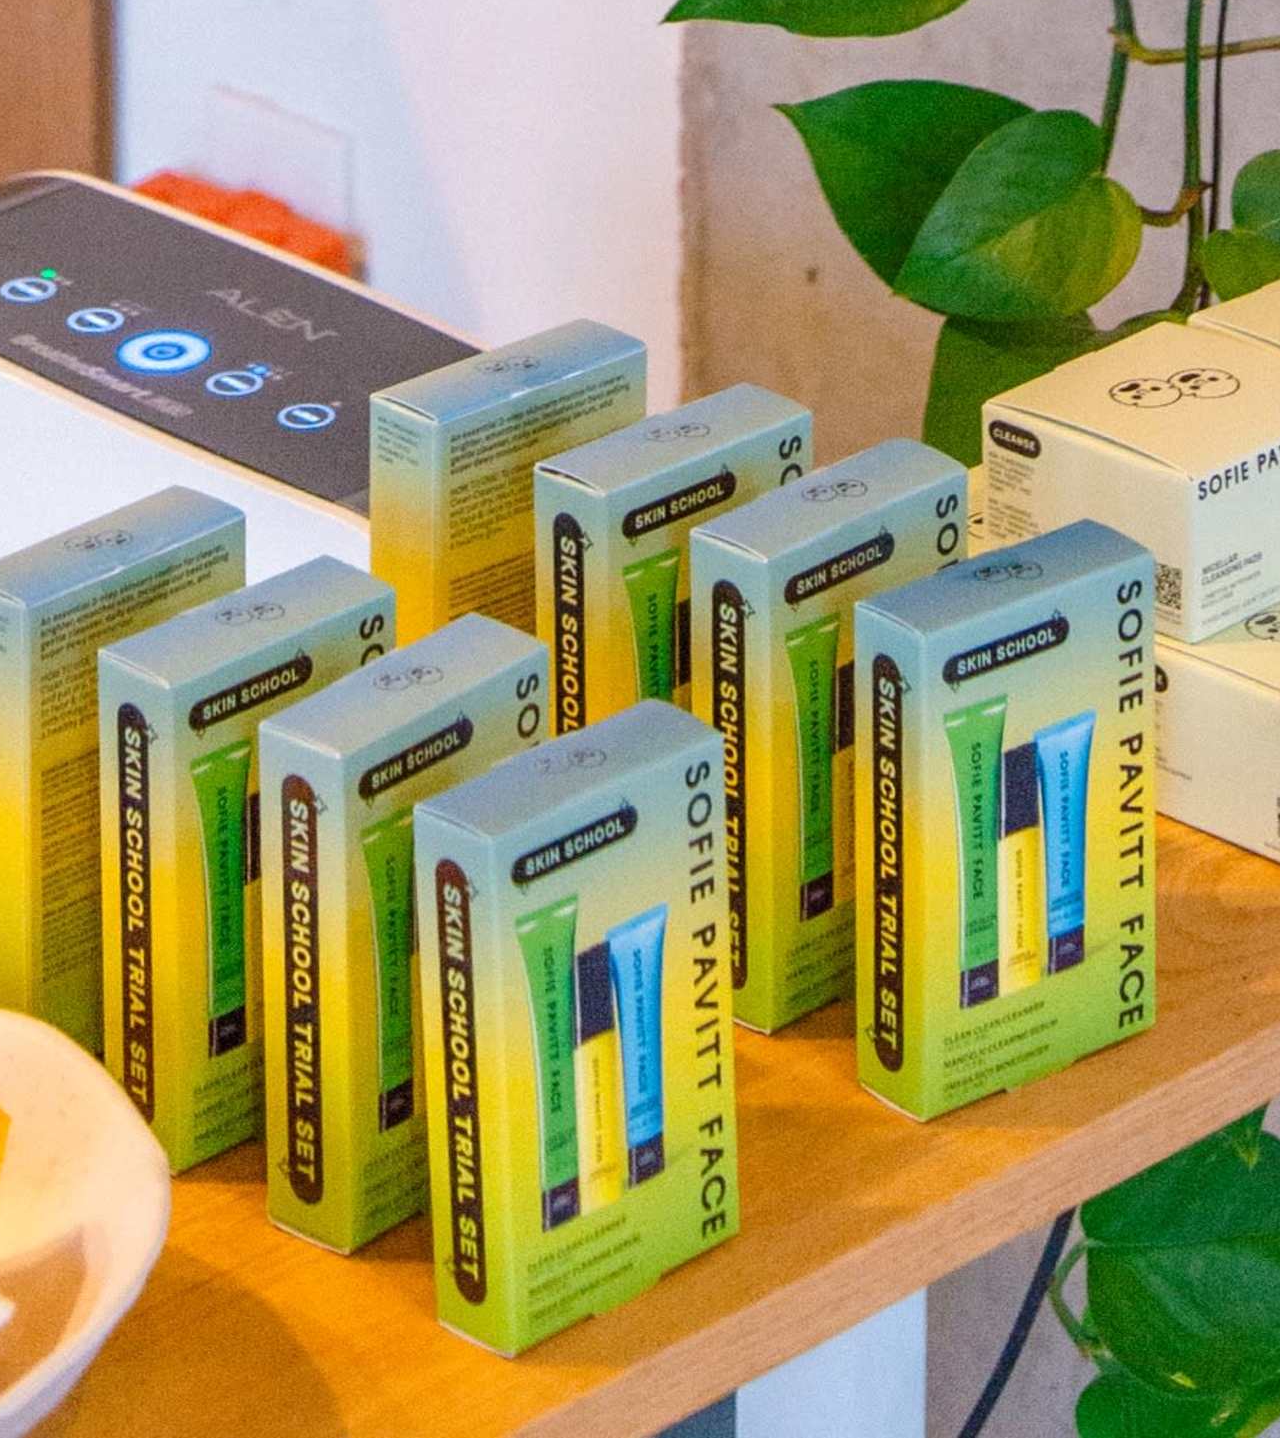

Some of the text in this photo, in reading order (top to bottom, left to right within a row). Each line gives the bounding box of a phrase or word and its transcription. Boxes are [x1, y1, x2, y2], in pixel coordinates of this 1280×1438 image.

[206, 288, 338, 342] ALEN
[992, 427, 1039, 453] CLEANSE
[634, 482, 726, 529] SKIN SCHOOL
[1197, 459, 1249, 501] SOFIE
[796, 544, 884, 597] SKIN SCHOOL
[559, 537, 580, 733] SKIN SCHOOL
[956, 627, 1057, 676] SKIN SCHOOL
[201, 665, 300, 723] SKIN SCHOOL
[719, 602, 739, 797] SKIN SCHOOL
[369, 731, 463, 791] SKIN SCHOOL
[1058, 750, 1069, 791] SOFIE
[970, 741, 985, 900] SOFIE PAVITT FACE
[1116, 579, 1146, 1029] SOFIE PAVITT FACE
[524, 817, 626, 876] SKIN SCHOOL
[878, 676, 898, 1051] SKIN SCHOOL TRIAL SET
[1060, 852, 1071, 889] FACE
[123, 724, 150, 1110] SKIN SCHOOL TRIAL SET
[288, 797, 317, 1184] SKIN SCHOOL TRIAL SET
[684, 759, 726, 1238] SOFIE PAVITT FACE
[443, 884, 479, 1282] SKIN SCHOOL TRIAL SET
[550, 1069, 563, 1113] FACE
